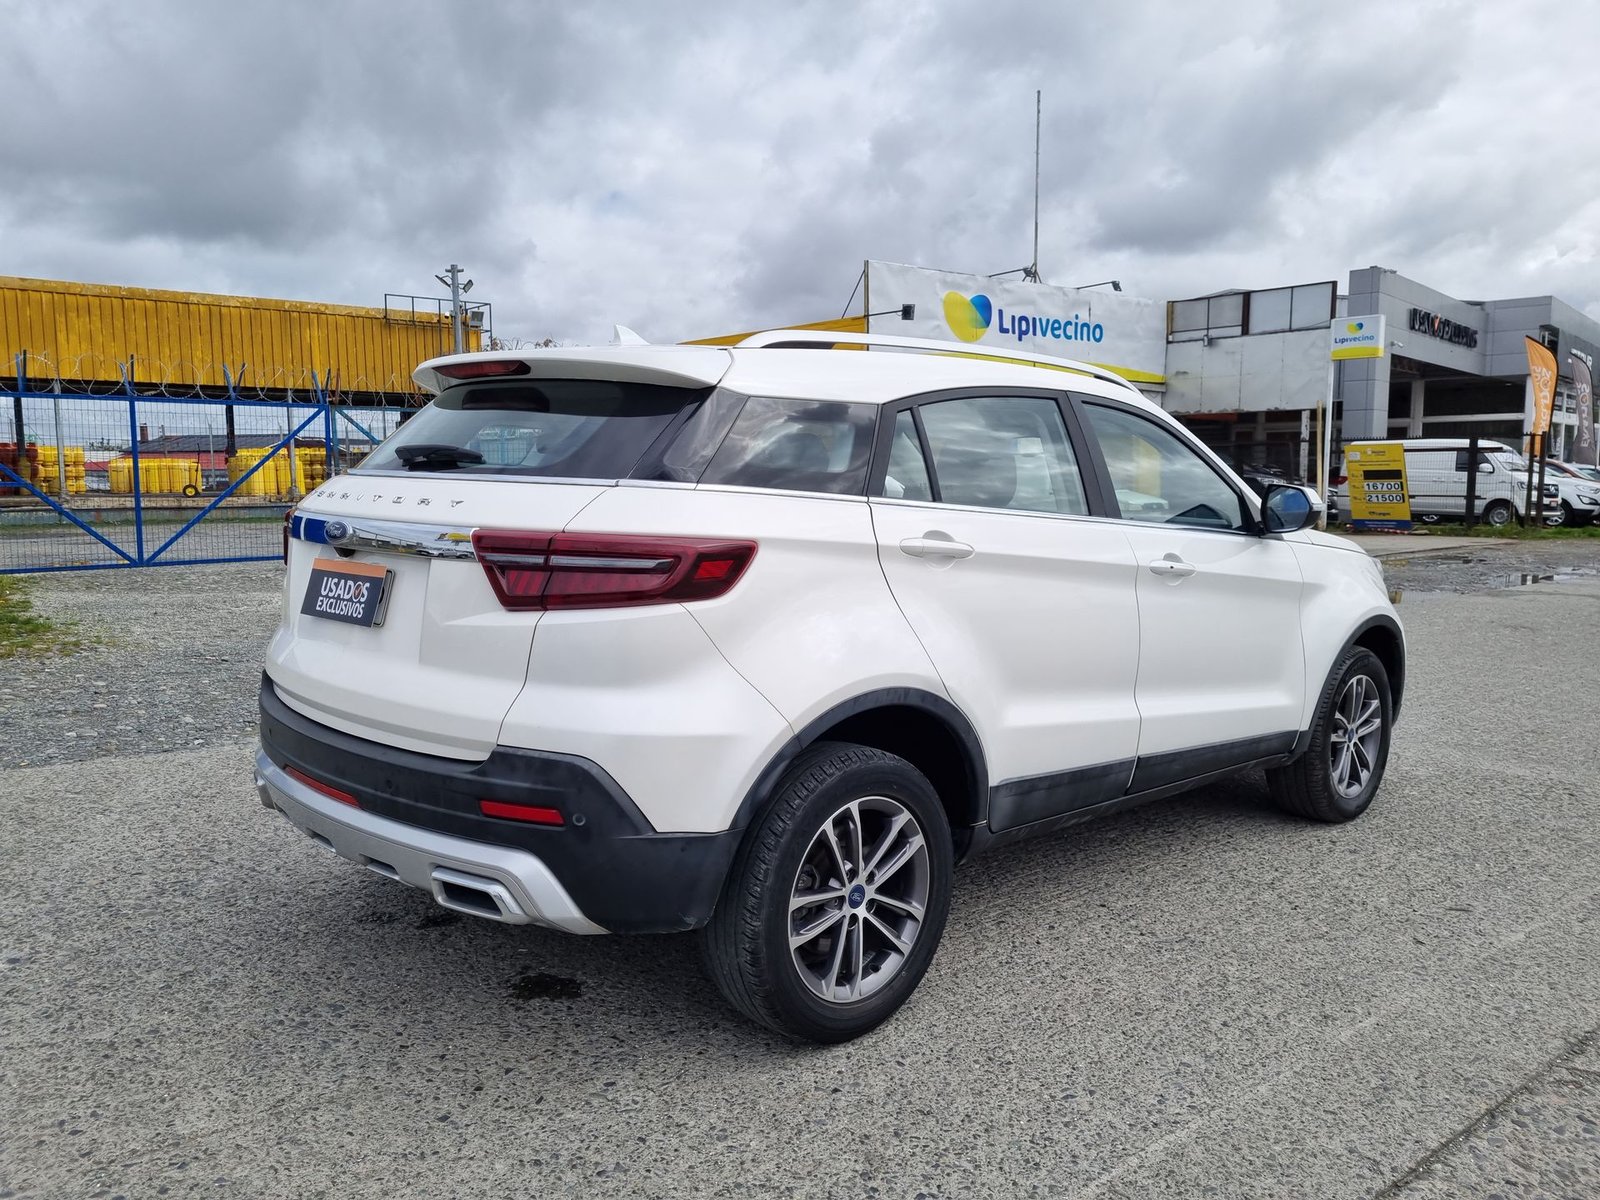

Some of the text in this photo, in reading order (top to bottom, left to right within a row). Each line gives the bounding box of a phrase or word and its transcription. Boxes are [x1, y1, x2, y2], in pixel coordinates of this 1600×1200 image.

[998, 309, 1104, 342] Lipivecino
[1334, 334, 1376, 344] Lipivecino
[1366, 482, 1400, 490] 16700
[1367, 494, 1402, 502] 21500
[320, 576, 370, 602] USADOS
[315, 596, 365, 618] EXCLUSIVOS
